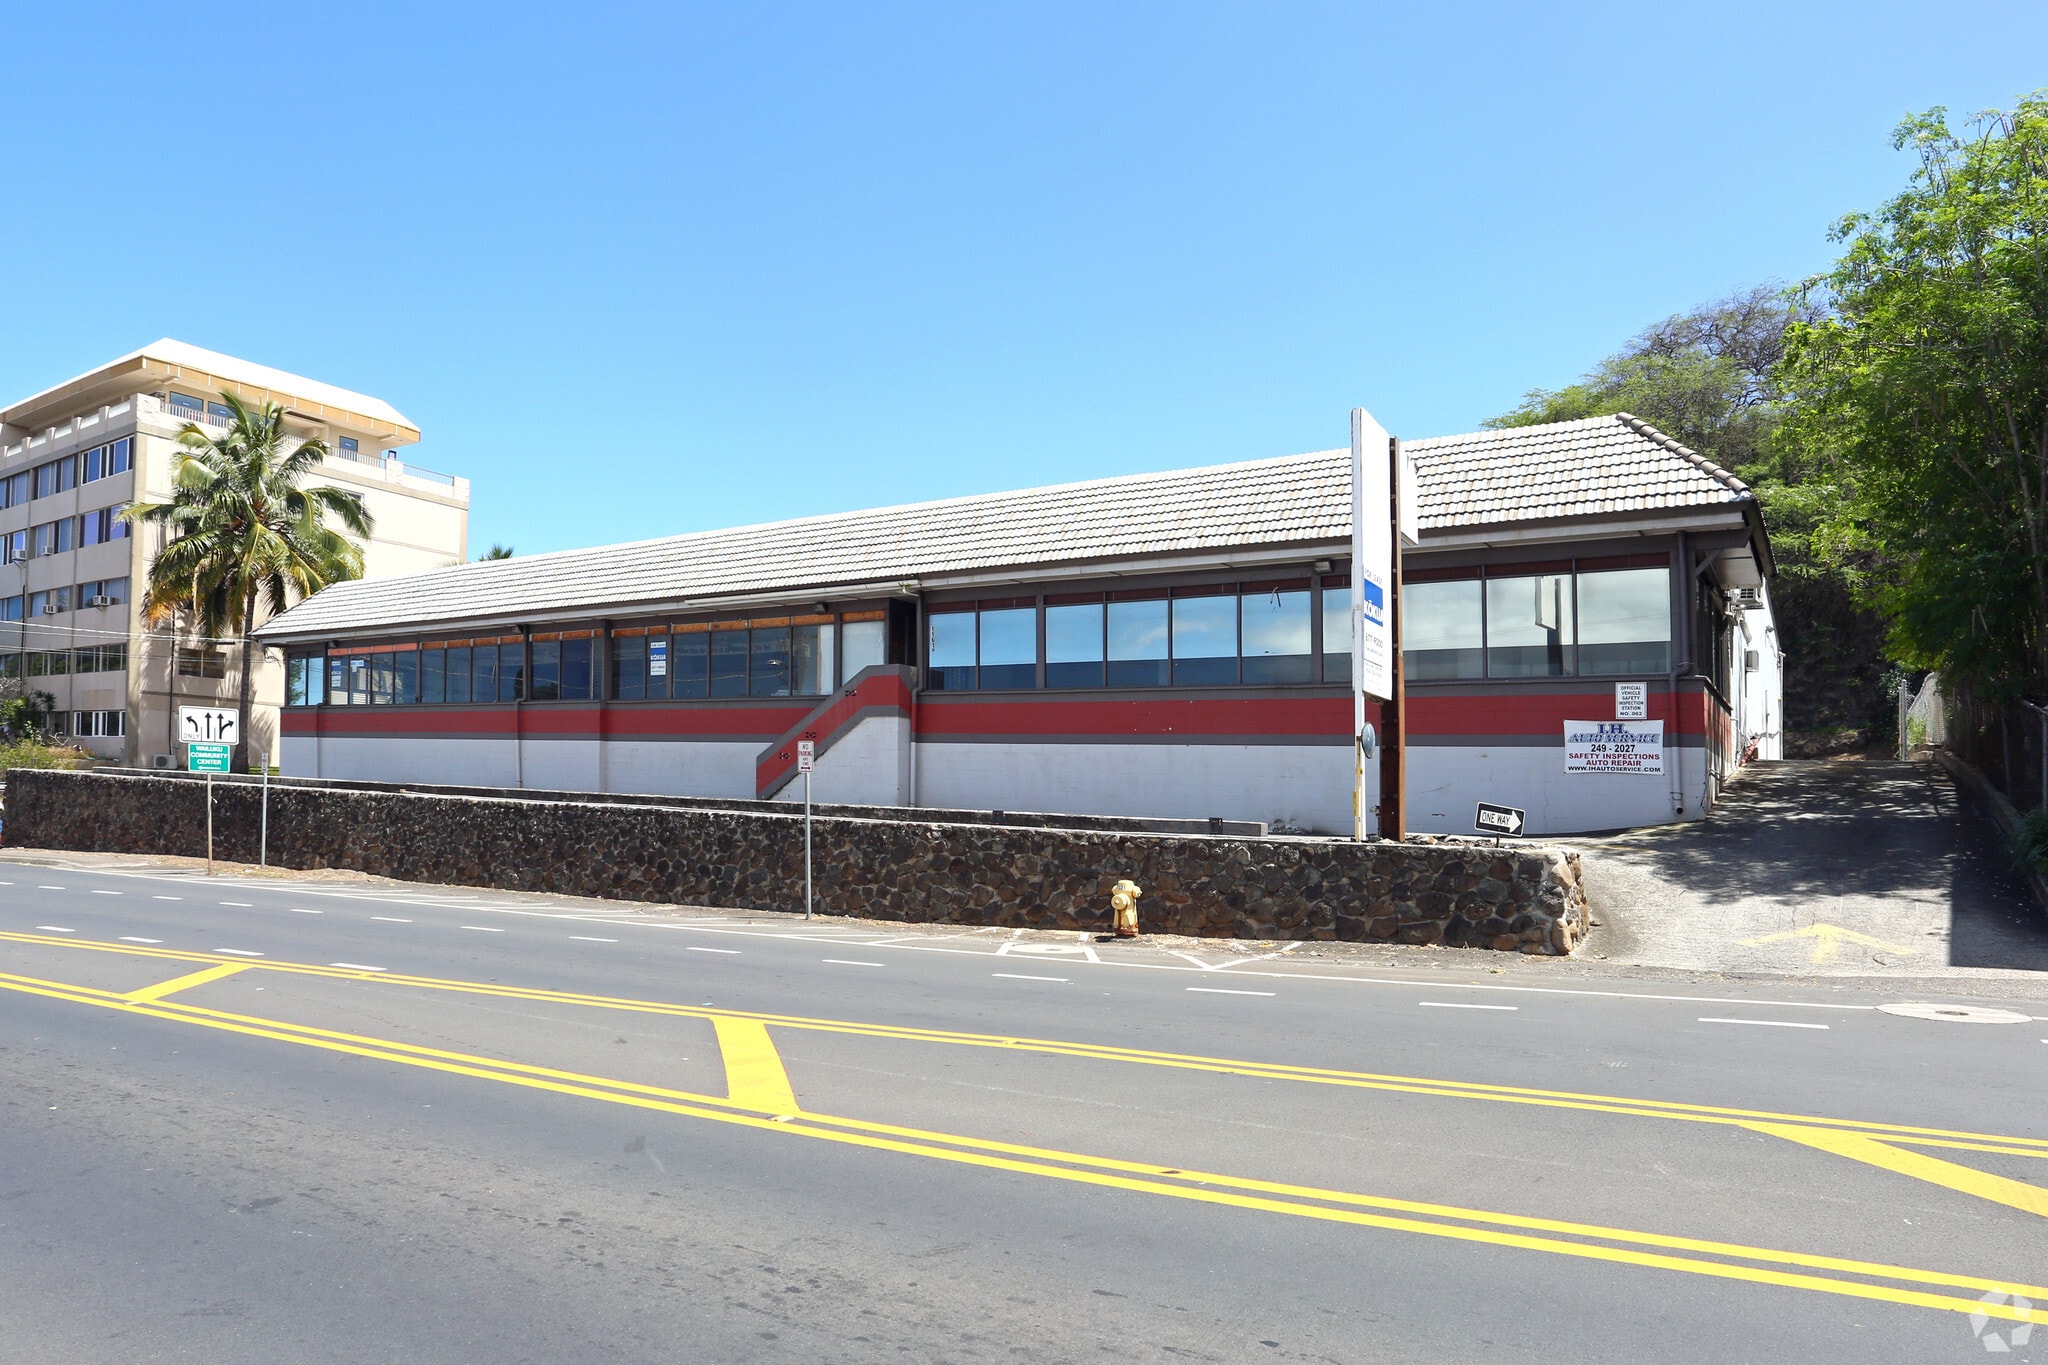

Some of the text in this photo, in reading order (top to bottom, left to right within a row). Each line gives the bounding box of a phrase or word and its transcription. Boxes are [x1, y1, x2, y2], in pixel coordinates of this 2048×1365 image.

[1597, 723, 1629, 734] I.H.
[1568, 733, 1660, 744] AUTO SERVICE
[1591, 744, 1606, 752] 249
[1614, 744, 1636, 752] 2027
[1482, 811, 1511, 826] ONE WAY
